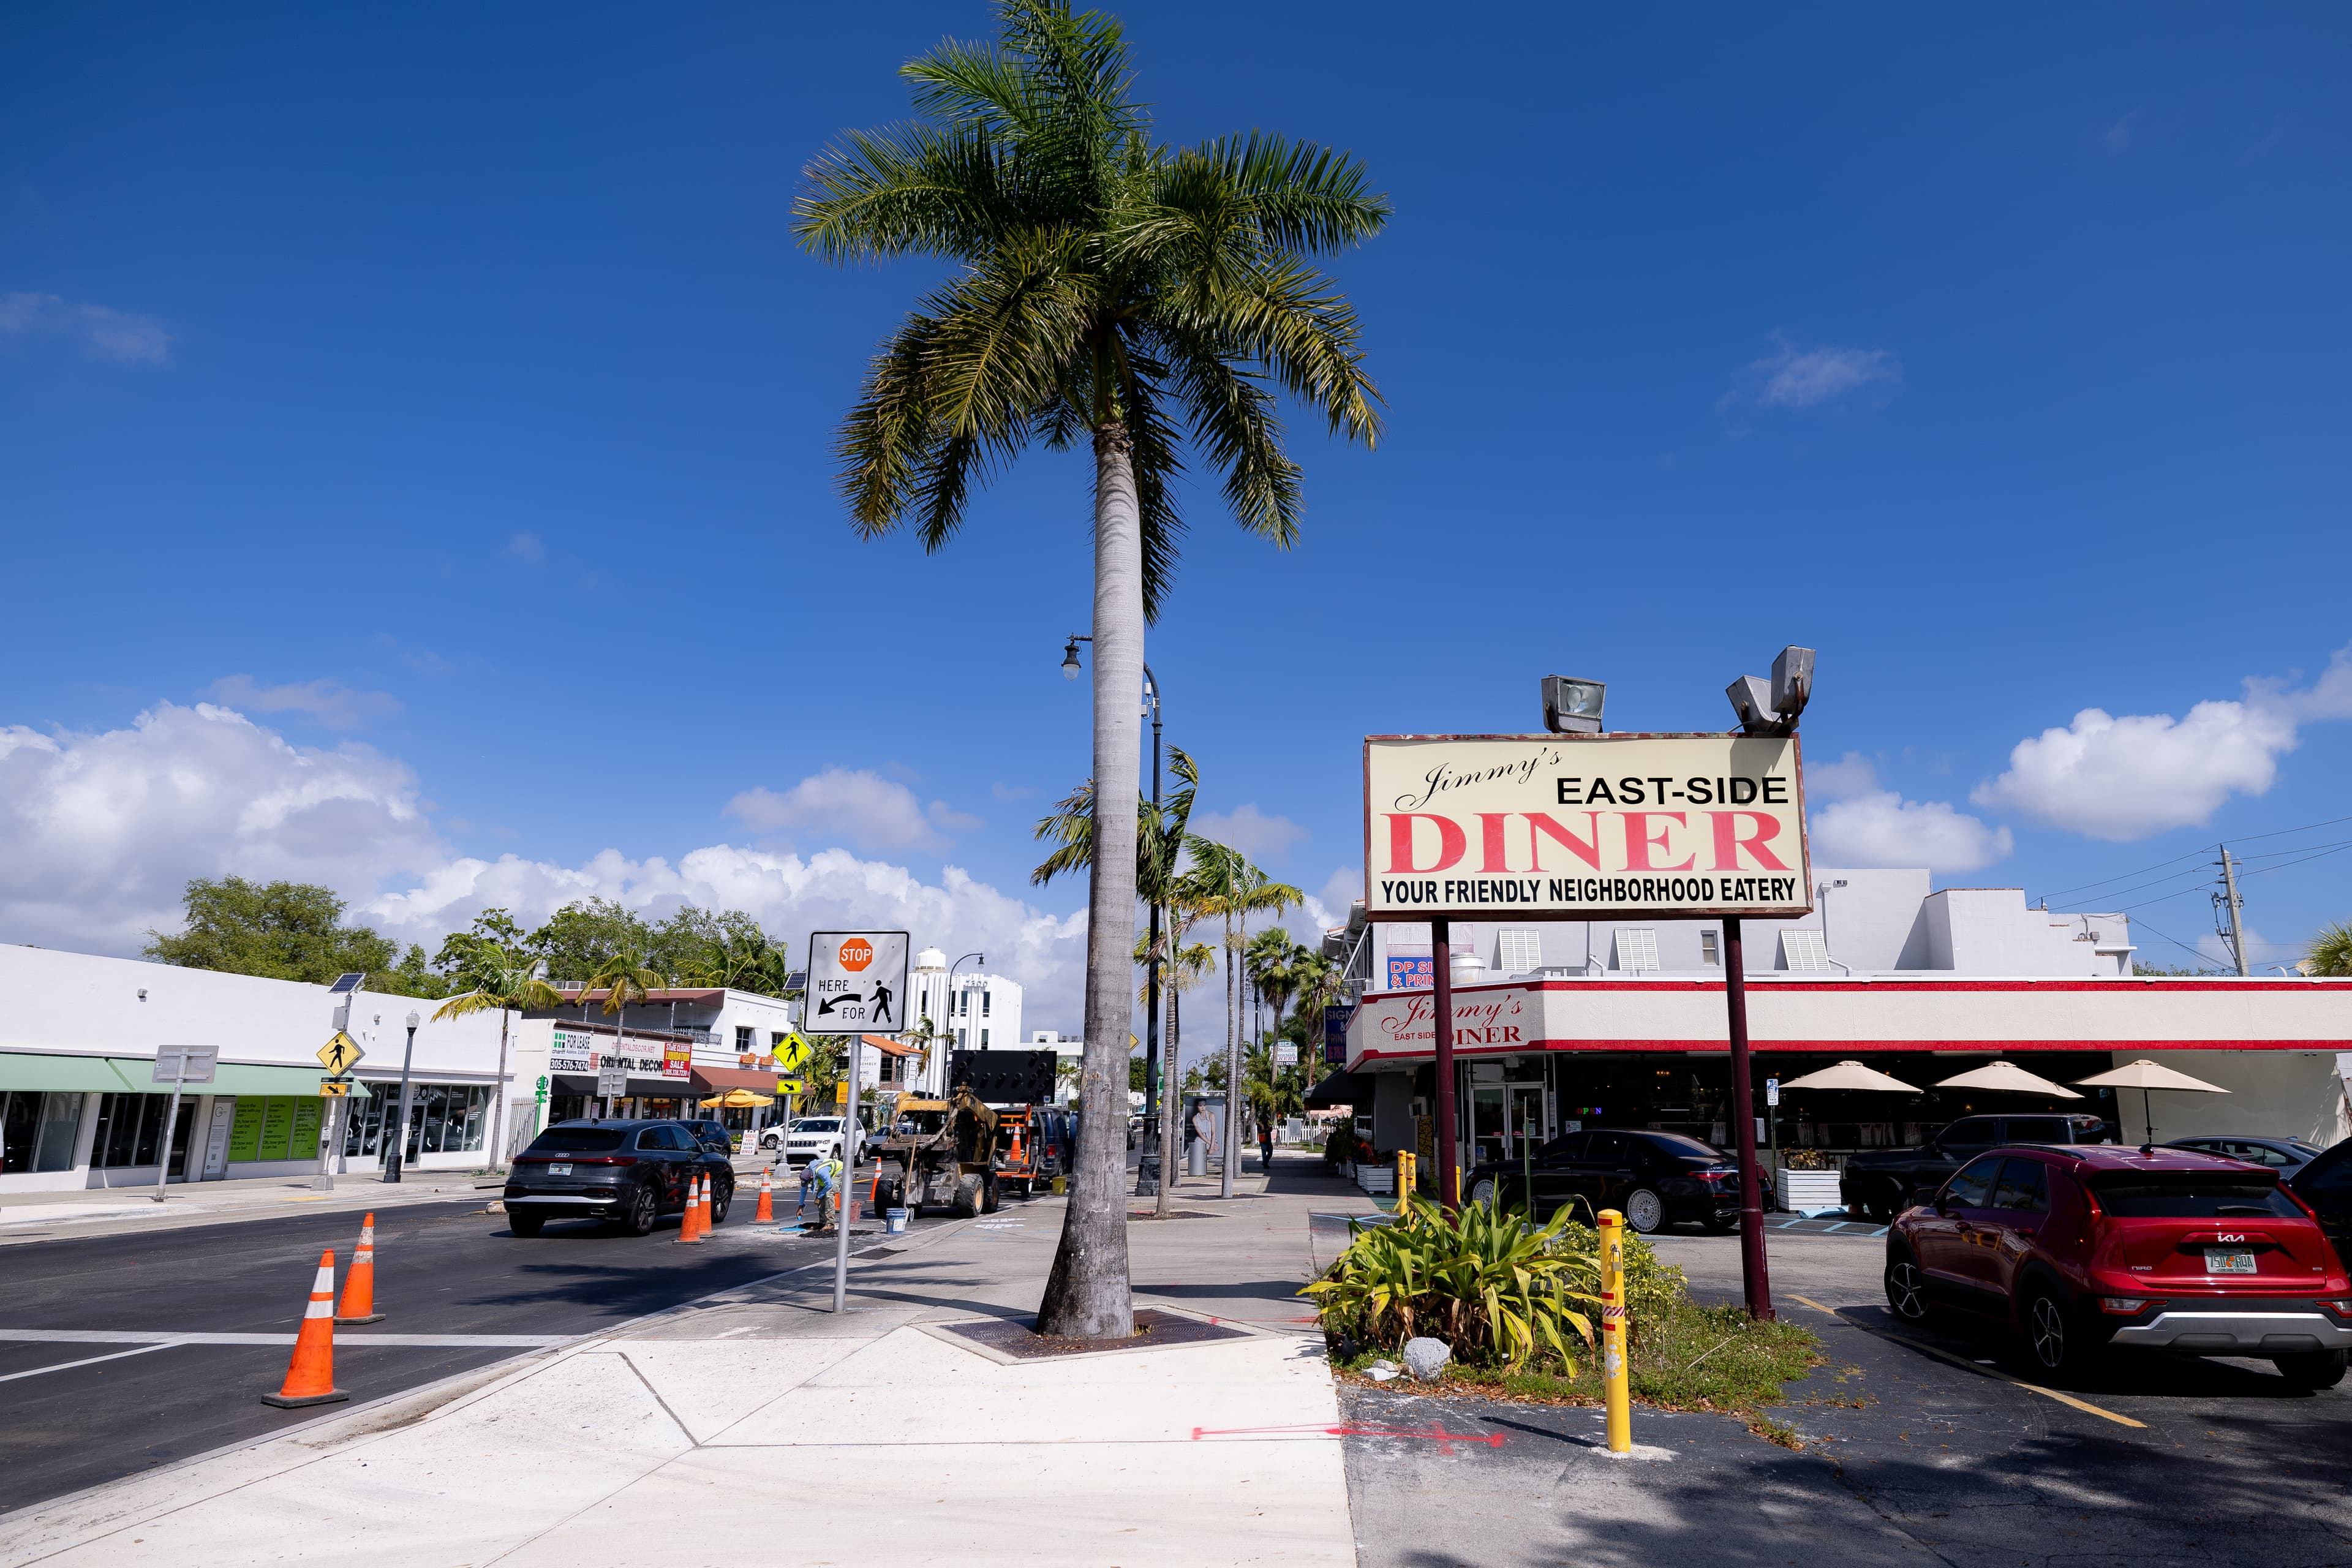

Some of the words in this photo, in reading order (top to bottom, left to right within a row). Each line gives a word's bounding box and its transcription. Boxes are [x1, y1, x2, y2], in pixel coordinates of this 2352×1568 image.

[1395, 747, 1562, 812] Jimmy's
[1557, 777, 1789, 805] EAST-SIDE
[1380, 811, 1795, 873] DINER
[1381, 880, 1442, 903] YOUR
[1446, 879, 1540, 903] FRIENDLY
[1550, 878, 1714, 902] NEIGHBORHOOD
[1721, 878, 1795, 901] EATERY
[841, 948, 872, 962] STOP
[1390, 962, 1414, 973] DP
[818, 980, 849, 992] HERE
[1391, 974, 1403, 986] &
[1406, 974, 1434, 986] PRIN
[842, 1008, 865, 1019] FOR
[1327, 1009, 1354, 1020] SIGN
[1381, 995, 1523, 1033] Jimy's
[567, 1035, 576, 1049] FOR
[577, 1036, 590, 1049] LEASE
[1452, 1027, 1522, 1045] INER
[551, 1060, 588, 1071] 305-576-7474
[600, 1056, 636, 1071] ORINTAL
[639, 1059, 663, 1072] DECOR
[669, 1060, 684, 1069] SALE
